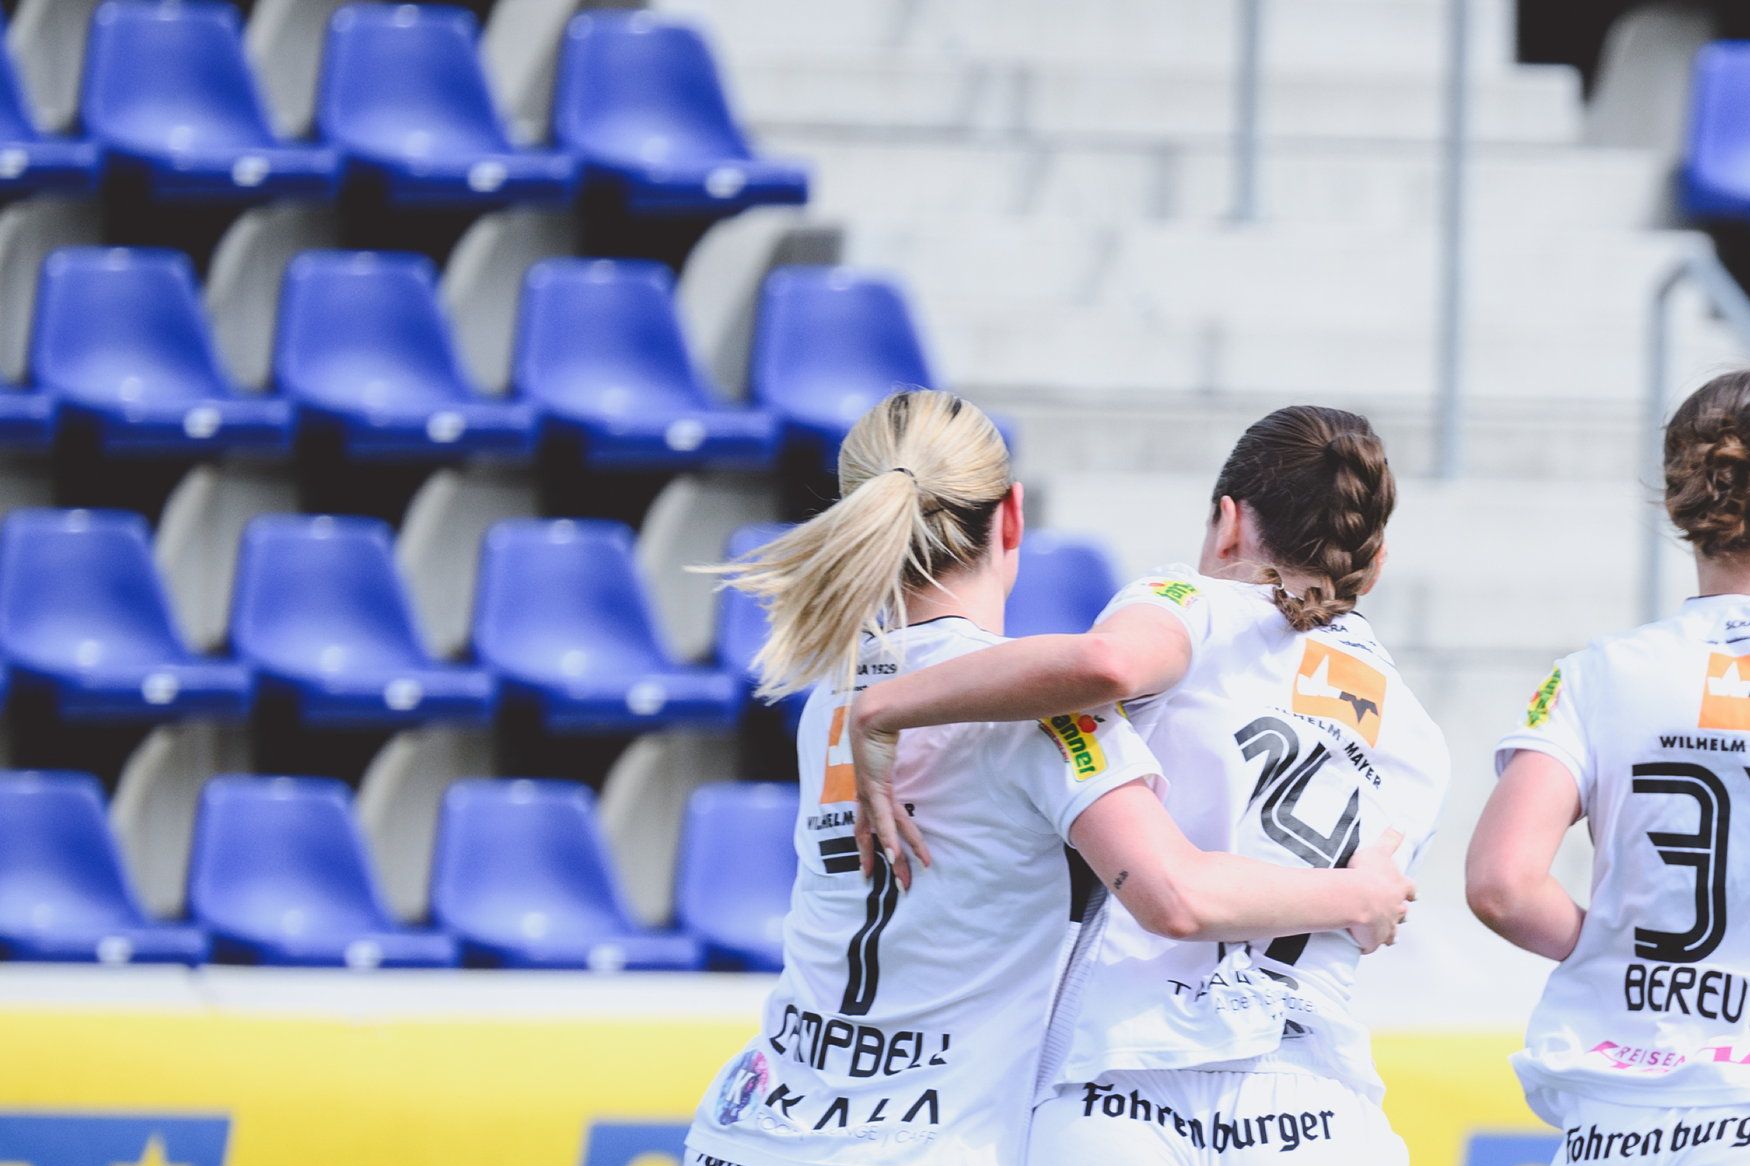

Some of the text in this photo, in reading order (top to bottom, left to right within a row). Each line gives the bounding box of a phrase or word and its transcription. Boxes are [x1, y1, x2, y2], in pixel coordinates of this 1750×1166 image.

[1051, 713, 1096, 775] anner
[1343, 741, 1382, 789] MAYER
[1659, 735, 1747, 753] WILHELM
[818, 833, 899, 1016] 7
[1081, 1081, 1335, 1154] Fohrenburger
